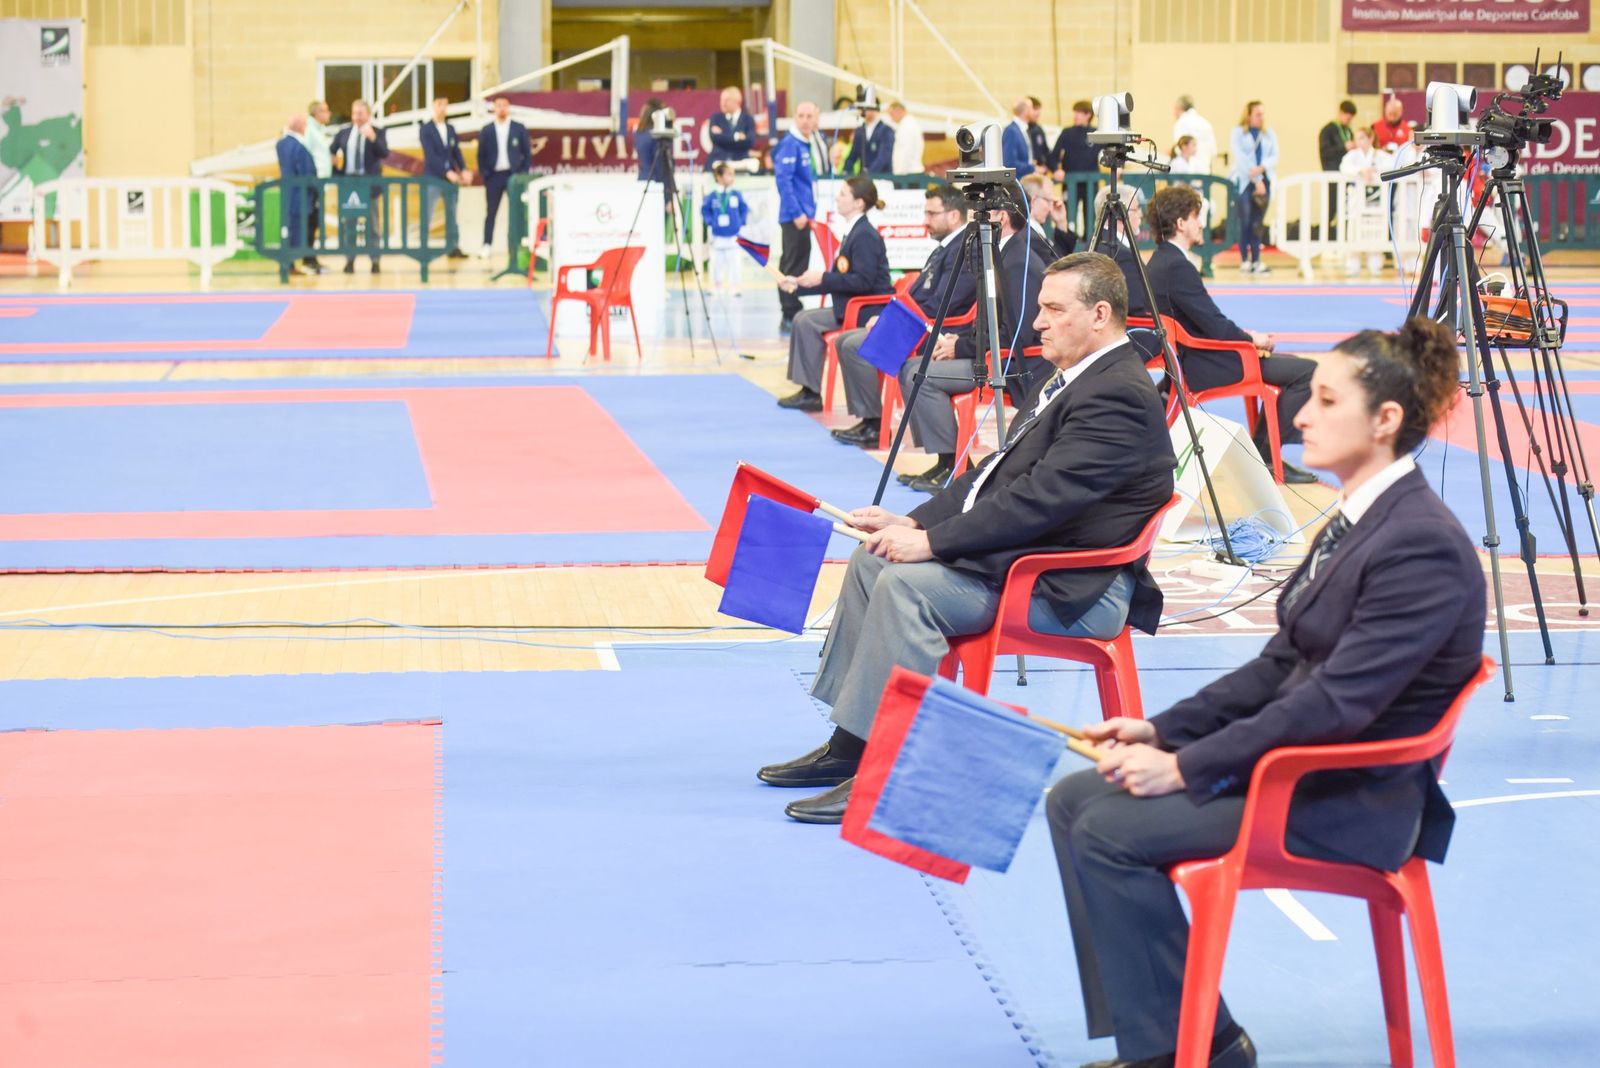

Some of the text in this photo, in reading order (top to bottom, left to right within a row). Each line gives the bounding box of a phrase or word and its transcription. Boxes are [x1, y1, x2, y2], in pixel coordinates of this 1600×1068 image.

[1352, 7, 1400, 20] Instituto
[1401, 8, 1457, 23] Municipal
[1458, 8, 1474, 21] de
[1476, 8, 1529, 22] Deportes
